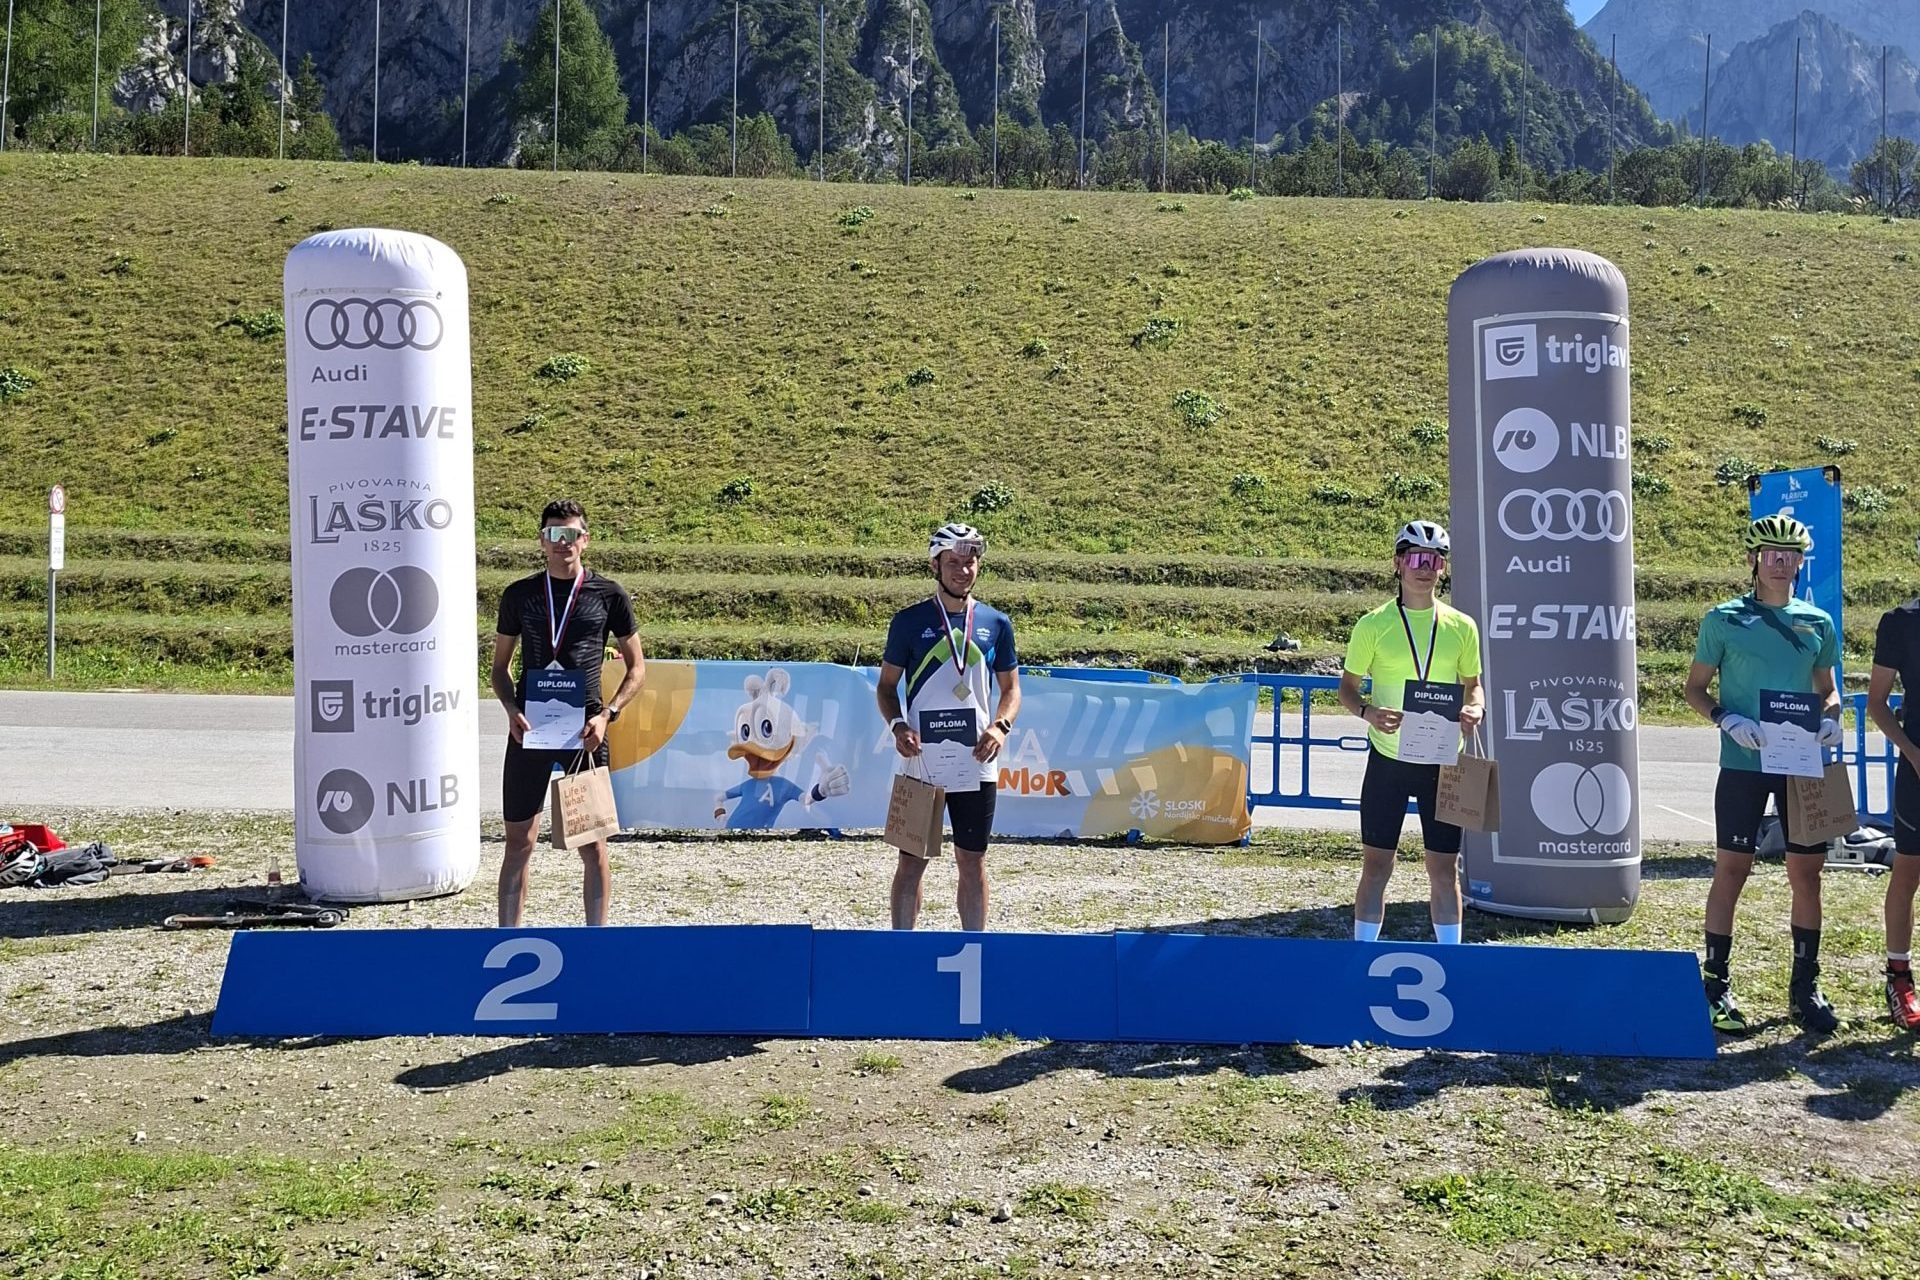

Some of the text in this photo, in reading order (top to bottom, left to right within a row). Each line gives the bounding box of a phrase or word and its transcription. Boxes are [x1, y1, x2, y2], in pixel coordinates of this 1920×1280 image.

[1546, 333, 1628, 373] triglav
[311, 364, 368, 383] Audi
[1570, 422, 1628, 460] NLB
[328, 478, 432, 494] PIVOVARNA
[309, 494, 453, 544] LAŠKO
[363, 541, 401, 552] 1825
[1506, 555, 1571, 573] Audi
[335, 637, 437, 656] mastercard
[537, 680, 577, 689] DIPLOMA
[1530, 676, 1625, 691] PIVOVARNA
[362, 684, 461, 726] triglav
[1414, 691, 1454, 702] DIPLOMA
[1503, 689, 1636, 741] LAŠKO
[1769, 701, 1811, 712] DIPLOMA
[929, 719, 968, 729] DIPLOMA
[1568, 739, 1604, 754] 1825
[997, 766, 1072, 797] NIOR
[386, 773, 459, 816] NLB
[564, 786, 579, 799] Life
[758, 783, 775, 808] A
[564, 795, 586, 808] what
[1164, 800, 1207, 811] SLOSKI
[566, 808, 579, 817] we
[567, 813, 591, 827] make
[1538, 838, 1631, 855] mastercard
[473, 937, 563, 1020] 2
[936, 943, 982, 1024] 1
[1368, 952, 1454, 1037] 3
